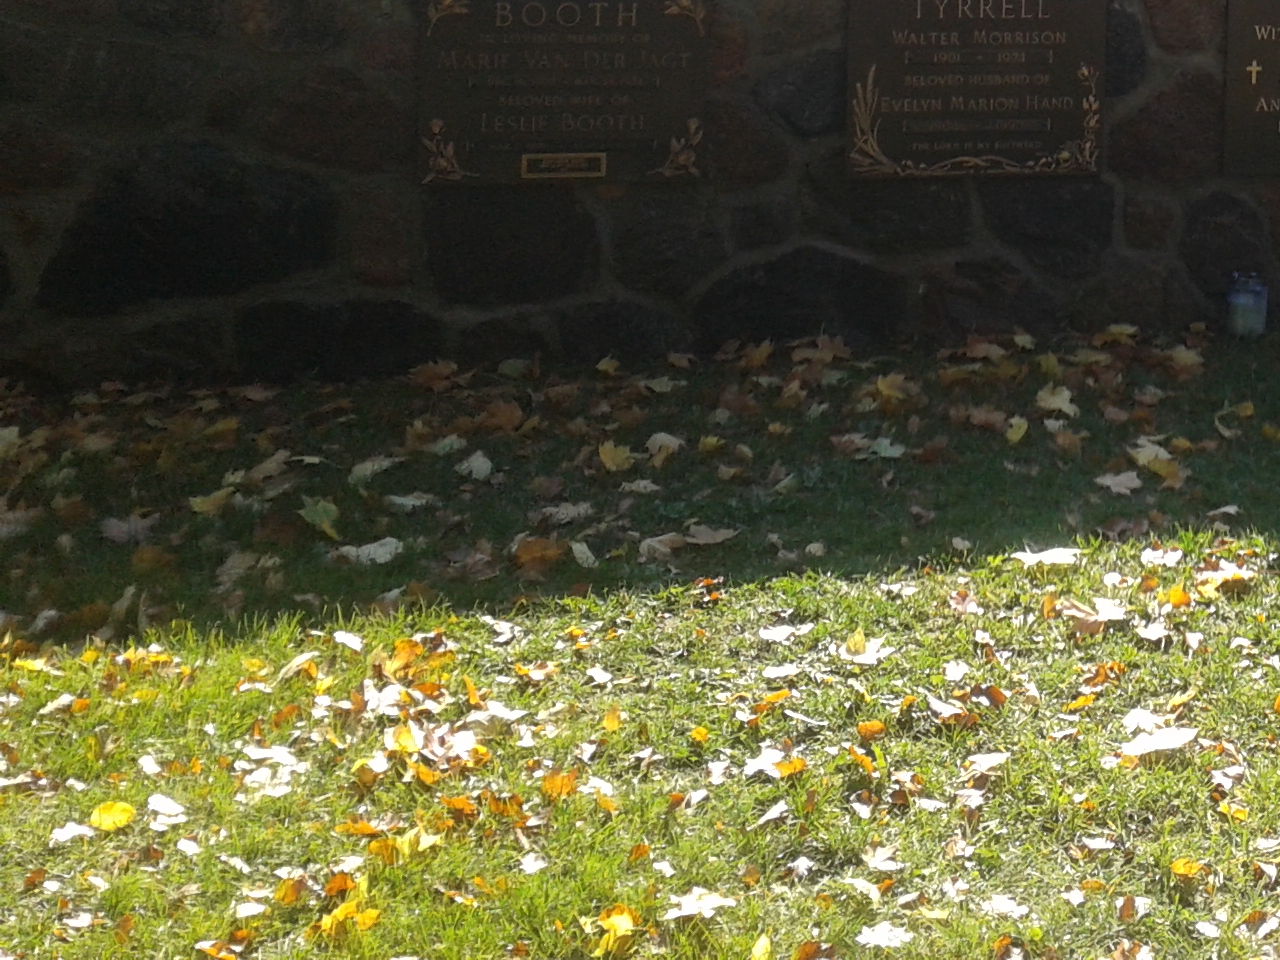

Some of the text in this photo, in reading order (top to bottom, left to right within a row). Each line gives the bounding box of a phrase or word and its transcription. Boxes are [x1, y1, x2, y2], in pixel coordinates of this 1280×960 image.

[496, 1, 638, 27] BOOTH
[891, 29, 1067, 46] WALTER MORRISON
[904, 74, 964, 86] BELOVED
[968, 74, 1029, 86] HUSBAND
[880, 95, 1074, 112] EVELYN MARION HAND
[561, 112, 645, 132] BOOTH
